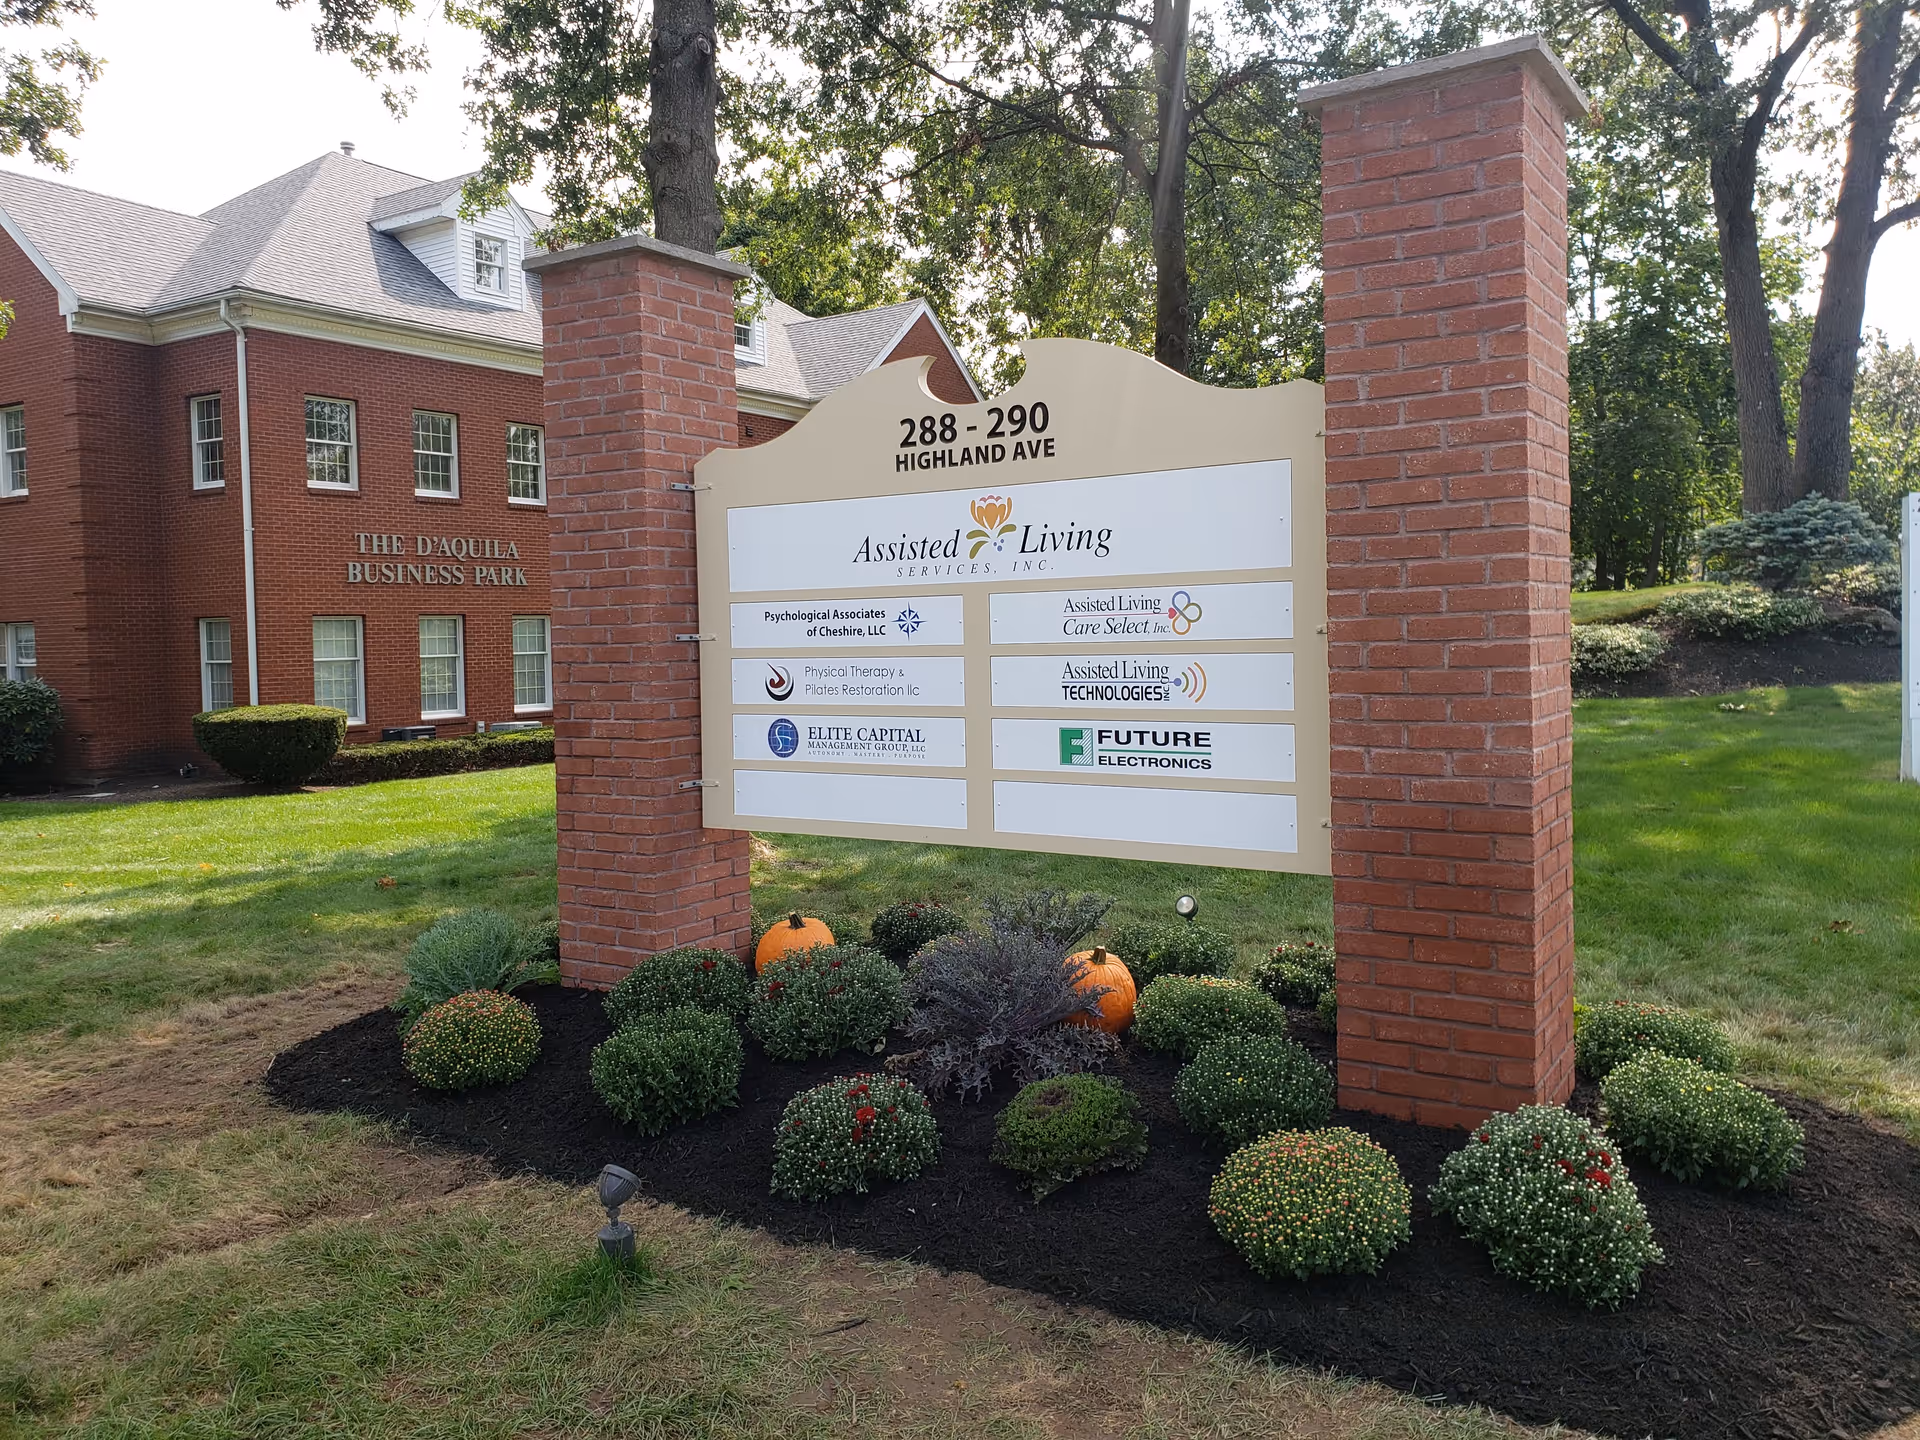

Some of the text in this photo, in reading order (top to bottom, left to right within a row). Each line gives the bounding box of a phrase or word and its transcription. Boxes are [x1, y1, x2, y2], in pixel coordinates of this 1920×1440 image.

[899, 412, 958, 448] 288
[985, 401, 1050, 438] 290
[895, 437, 1055, 473] HIGHLAND AVE
[355, 533, 519, 562] THE D'AQUILA
[853, 522, 1113, 564] Assisted Living
[346, 562, 528, 586] BUSINESS PARK
[896, 559, 1055, 578] SERVICES, INC.
[1063, 594, 1161, 614] Assisted Living
[764, 608, 886, 623] Psychological Associates
[806, 624, 886, 638] of Cheshire, LLC
[1063, 616, 1171, 636] Care Select, Inc.
[804, 665, 904, 679] Physical Therapy &
[1062, 660, 1170, 685] Assisted Living
[805, 683, 920, 697] Pilates Restoration llc
[1061, 685, 1163, 701] TECHNOLOGIES
[808, 726, 926, 743] ELITE CAPITAL
[1097, 730, 1211, 748] FUTURE
[807, 741, 926, 753] MANAGEMENT GROUP, LLC
[1098, 755, 1212, 770] ELECTRONICS
